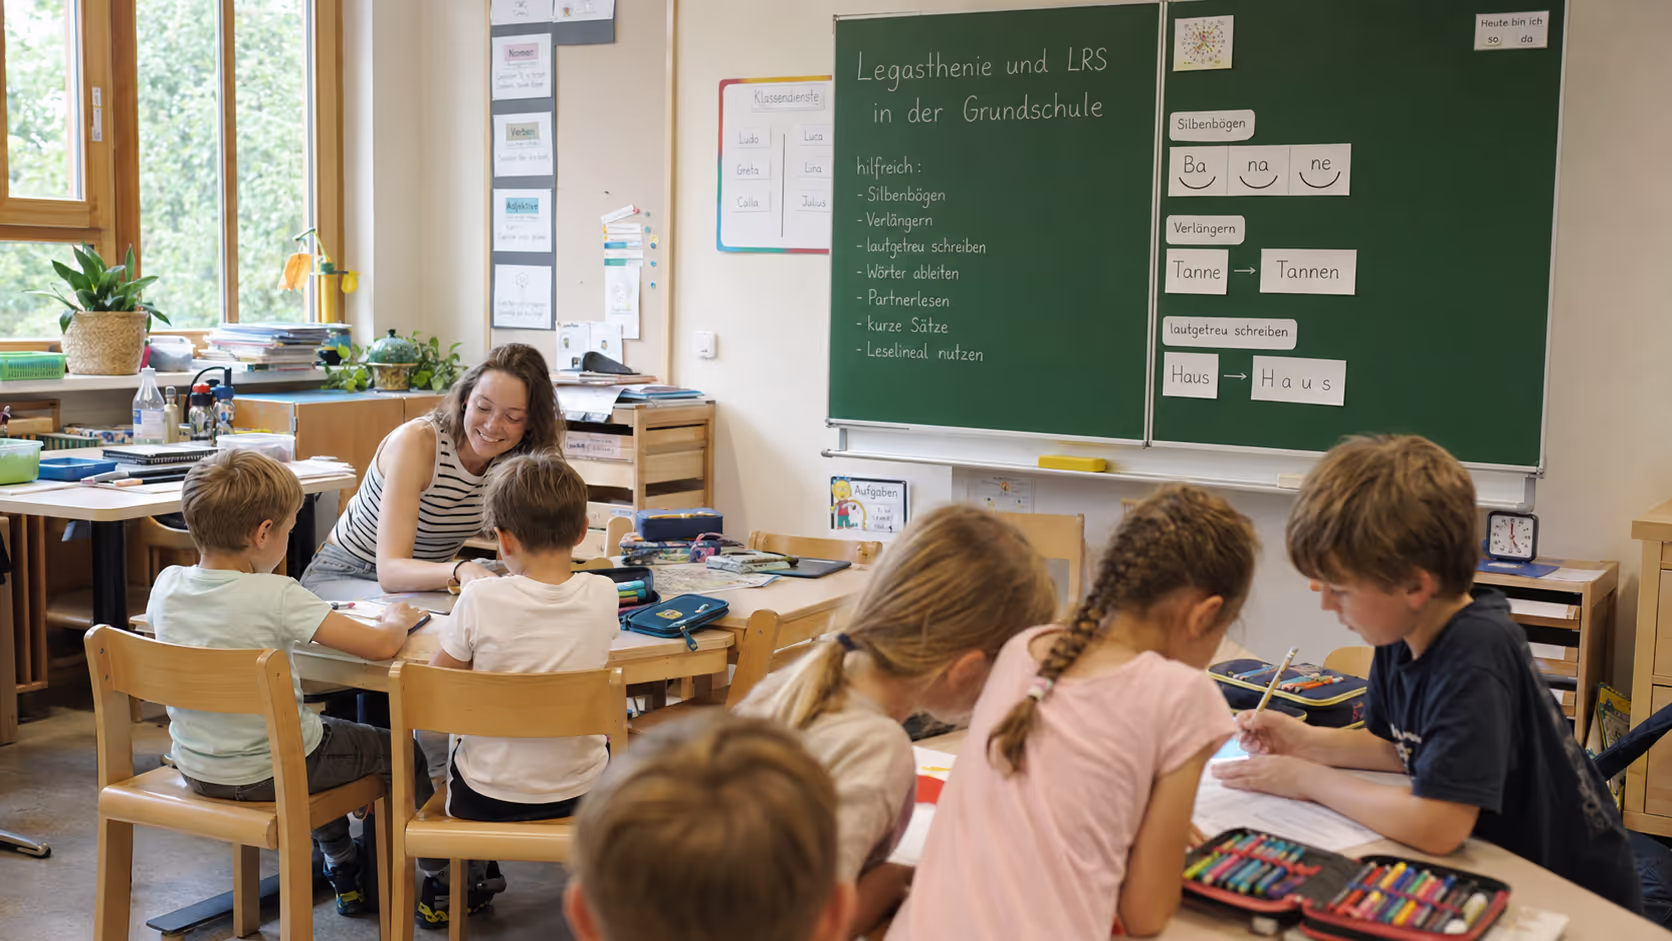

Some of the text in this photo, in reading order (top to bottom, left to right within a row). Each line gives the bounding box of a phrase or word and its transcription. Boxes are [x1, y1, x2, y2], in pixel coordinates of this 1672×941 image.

[1481, 17, 1543, 27] Heute bin ich
[1520, 35, 1533, 43] da
[857, 47, 1107, 91] Legasthenie und LRS
[754, 89, 820, 104] Klassendienste
[873, 92, 1103, 123] in der Grundschule
[1177, 117, 1246, 132] Silbenbögen
[1184, 155, 1332, 174] Ba na ne
[867, 185, 946, 208] Silbenbögen
[866, 212, 933, 233] Verlängern
[1173, 222, 1236, 237] Verlängern
[867, 237, 925, 259] lautgetreu
[931, 238, 986, 254] schreiben
[866, 264, 906, 280] Wörter
[913, 264, 959, 281] ableiten
[1173, 260, 1340, 281] Tanne Tannen
[868, 289, 950, 308] Partnerlesen
[867, 315, 902, 333] kurze
[911, 318, 949, 334] Sätze
[1170, 323, 1289, 338] lautgetreu schreiben
[867, 341, 928, 360] Leselineal
[938, 345, 984, 362] nutzen
[1171, 365, 1210, 386] Haus
[854, 484, 898, 500] Aufgaben
